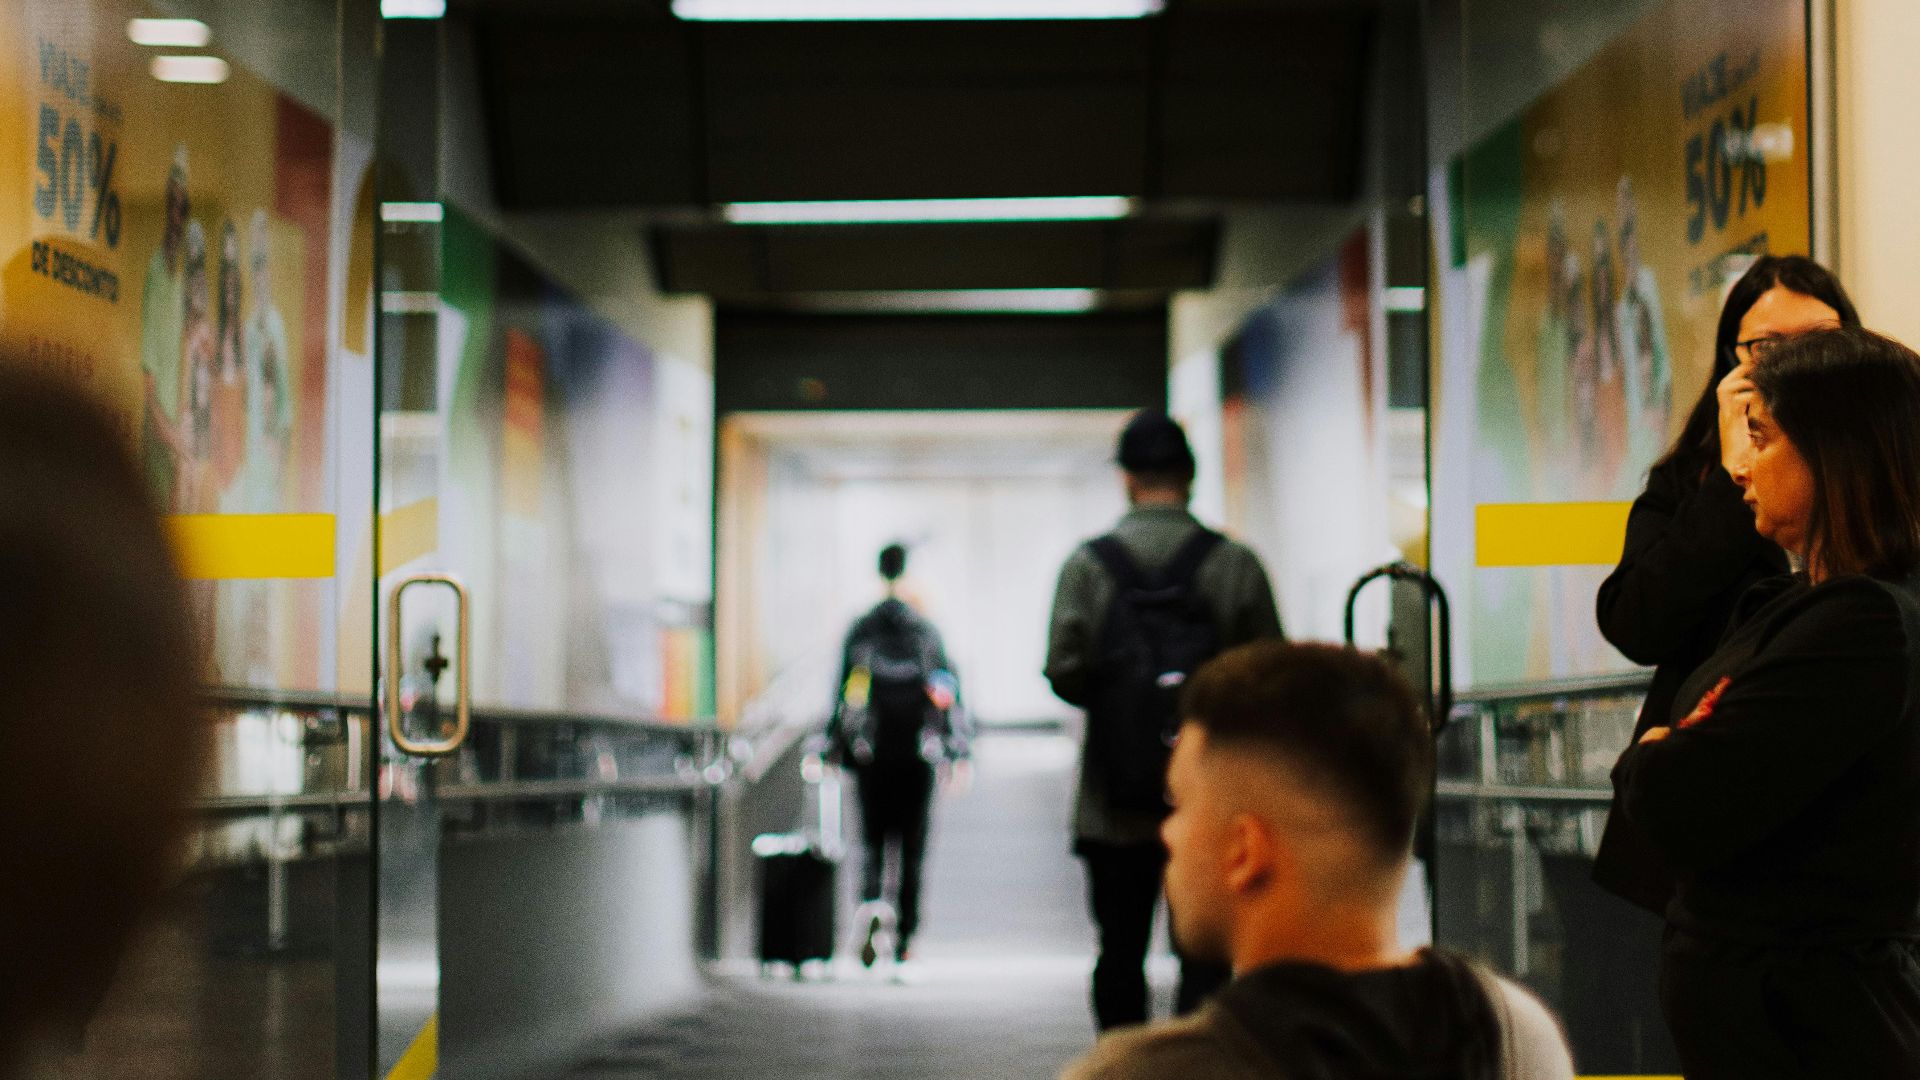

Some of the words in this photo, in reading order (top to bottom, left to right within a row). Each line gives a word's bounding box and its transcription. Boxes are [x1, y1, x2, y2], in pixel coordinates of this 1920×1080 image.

[33, 102, 122, 250] 50%
[1685, 96, 1767, 246] 50%
[31, 240, 50, 277] DE
